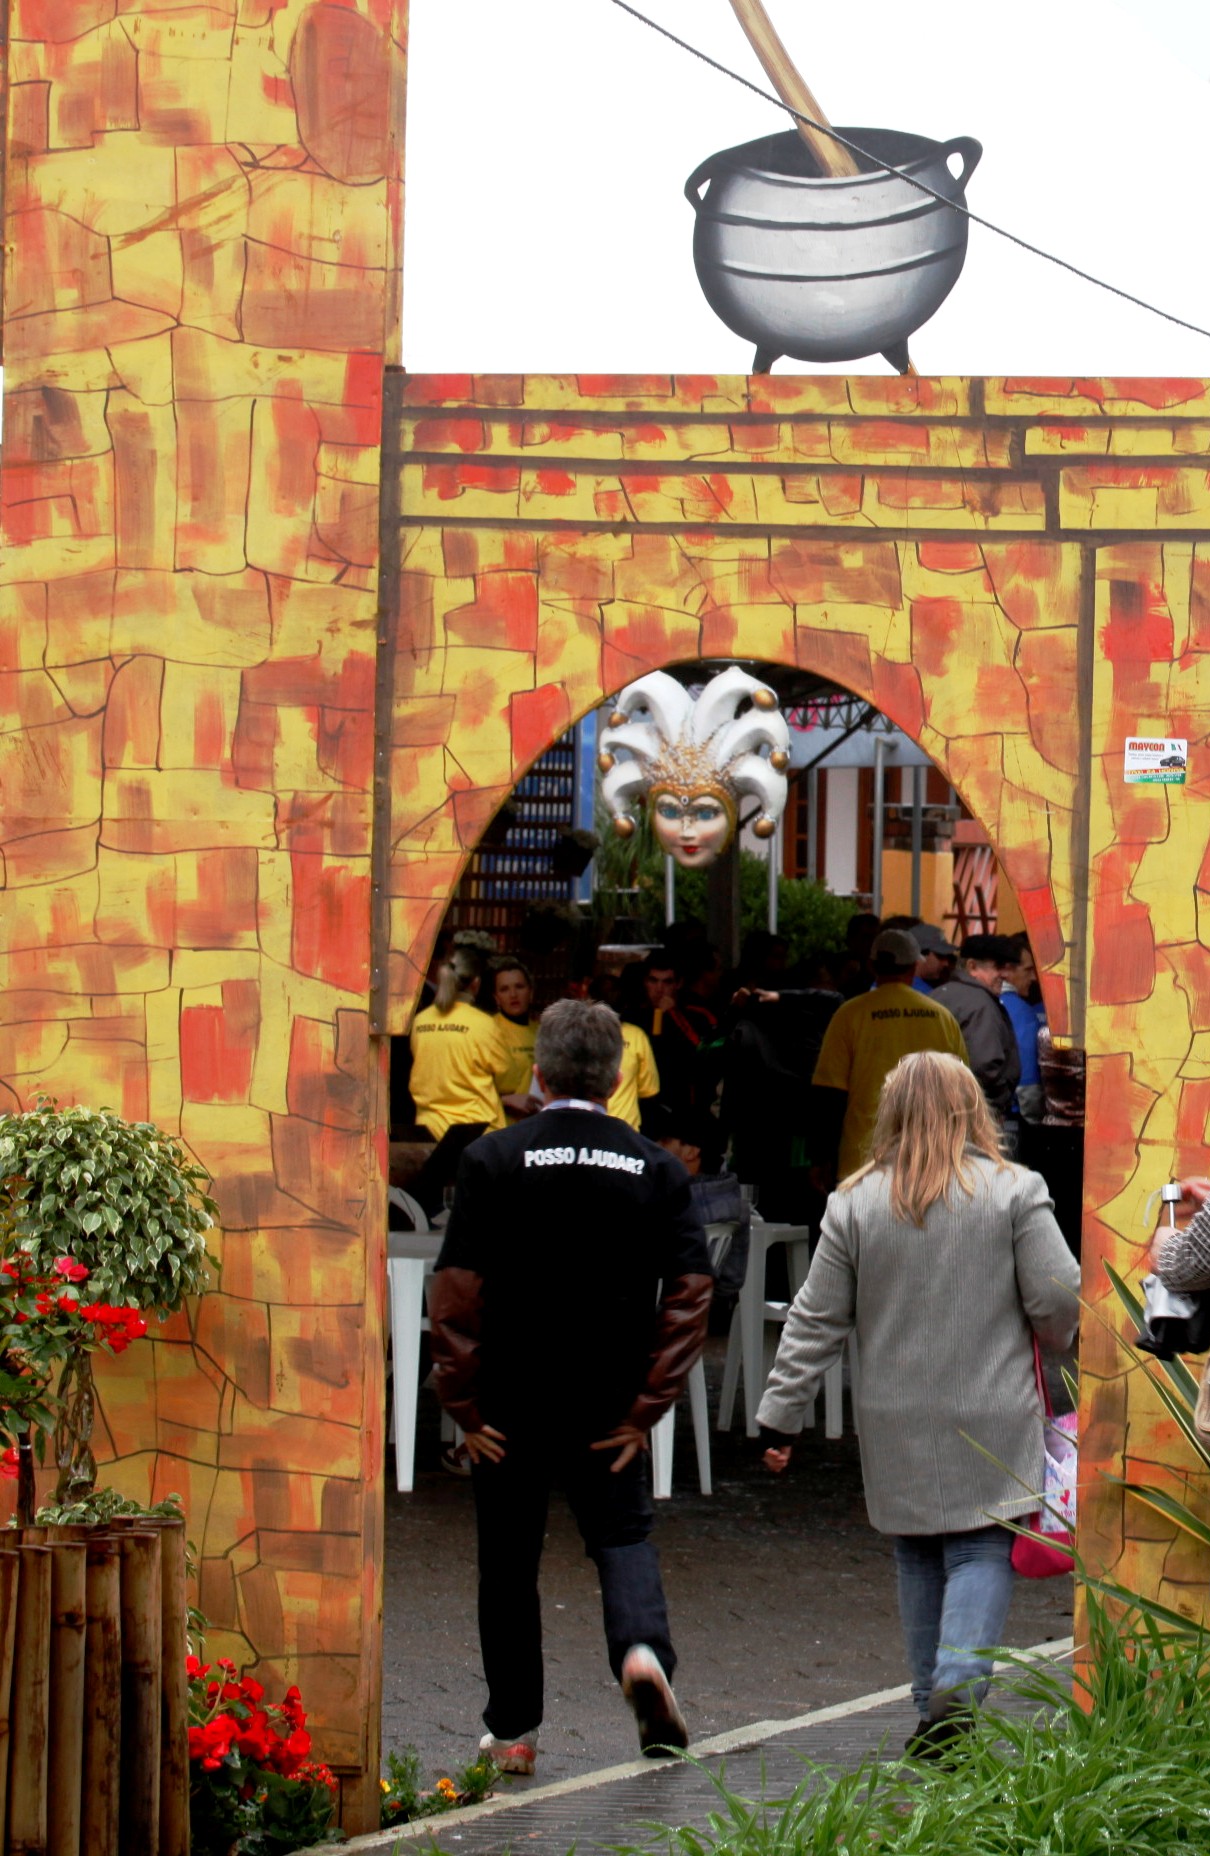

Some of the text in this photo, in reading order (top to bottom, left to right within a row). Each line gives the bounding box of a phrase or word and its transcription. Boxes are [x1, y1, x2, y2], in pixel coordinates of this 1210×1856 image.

[871, 1008, 901, 1021] POSSO
[524, 1146, 646, 1175] POSSO AJUDAR?
